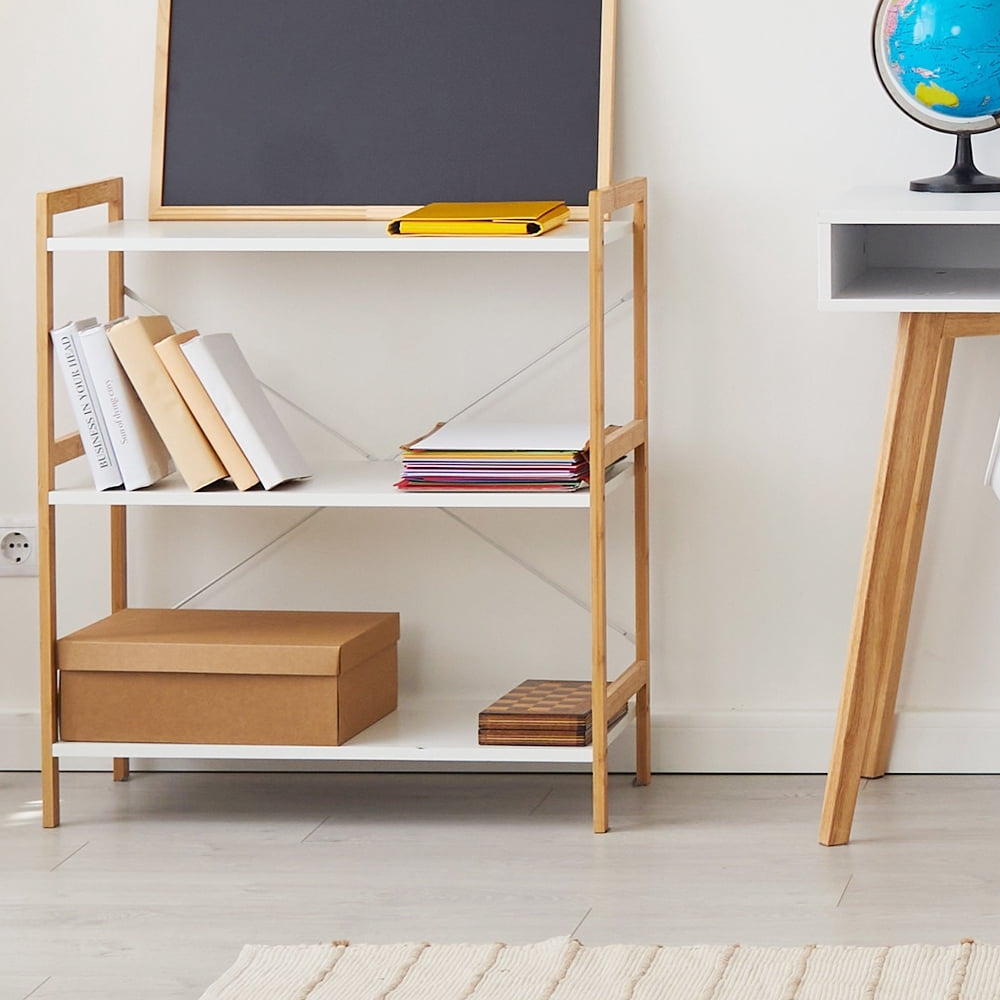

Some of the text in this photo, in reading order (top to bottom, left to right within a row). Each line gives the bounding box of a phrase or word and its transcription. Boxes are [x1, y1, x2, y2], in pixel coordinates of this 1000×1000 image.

[61, 336, 108, 469] BUSINESS IN YOUR HEAD
